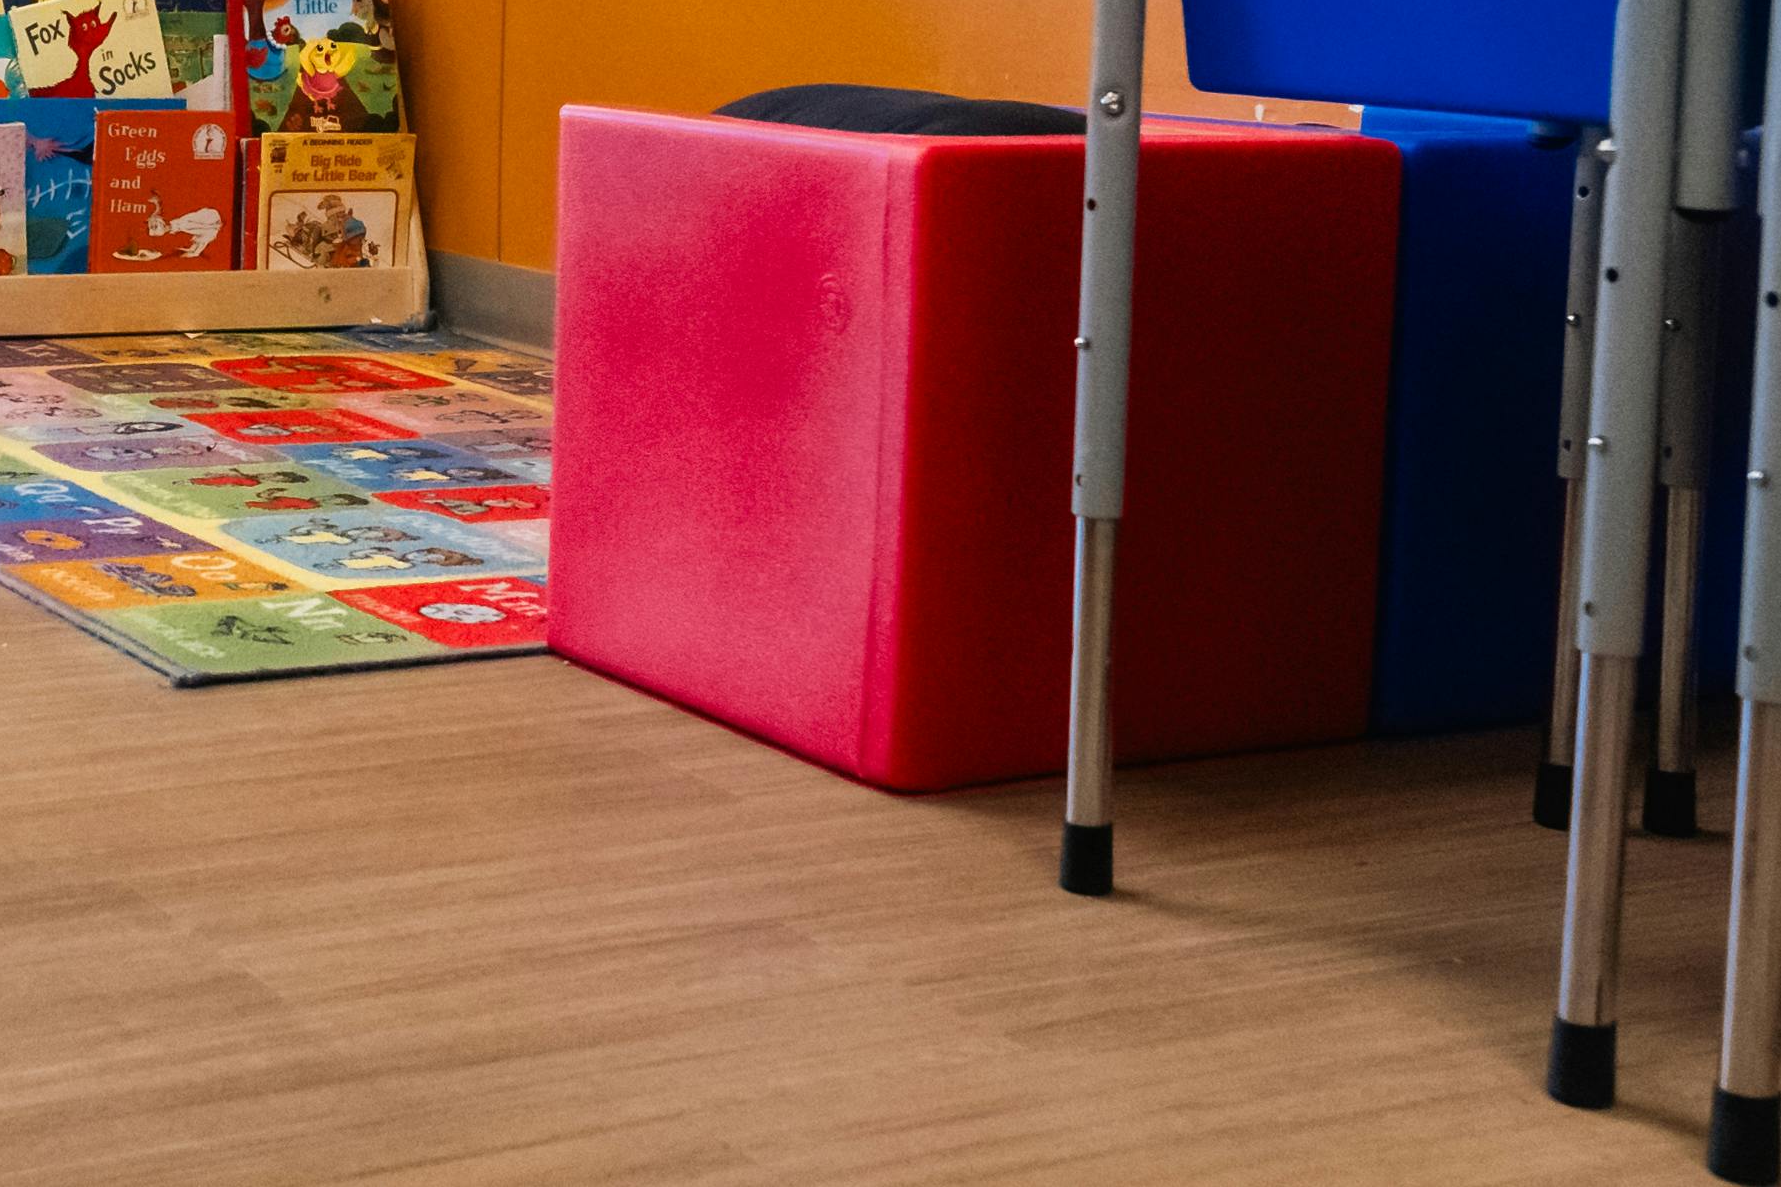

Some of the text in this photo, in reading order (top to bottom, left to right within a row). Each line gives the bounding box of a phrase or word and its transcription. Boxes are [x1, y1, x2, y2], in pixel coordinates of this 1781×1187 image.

[294, 0, 338, 16] Little
[25, 19, 66, 56] Fox
[101, 48, 114, 62] in
[98, 51, 157, 96] Socks
[107, 122, 158, 139] Green
[125, 146, 167, 170] Eggs
[310, 154, 363, 170] Big Ride
[109, 175, 141, 190] and
[291, 169, 378, 183] for Little Bear
[109, 198, 148, 214] Ham
